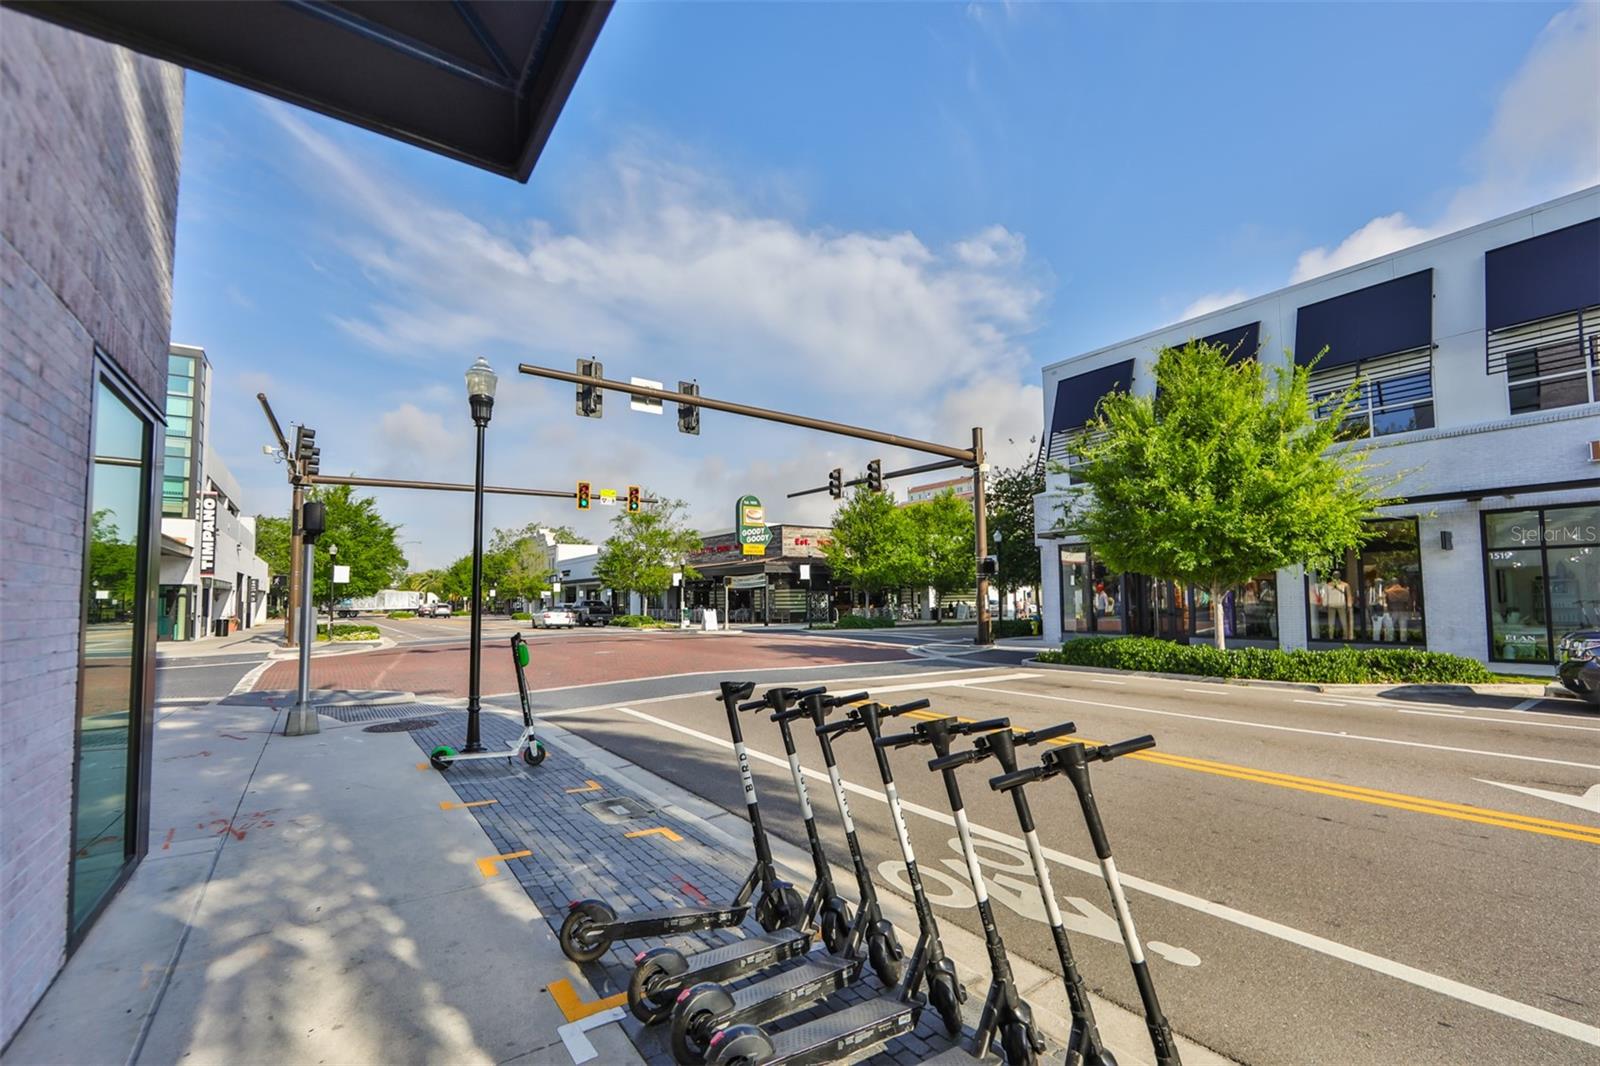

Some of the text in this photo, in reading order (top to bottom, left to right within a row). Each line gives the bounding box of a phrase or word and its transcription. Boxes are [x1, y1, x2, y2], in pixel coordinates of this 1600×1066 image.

[201, 498, 215, 570] TIMPANO
[741, 528, 765, 537] GOODY
[746, 534, 770, 543] GOODY
[739, 753, 754, 792] BIRD
